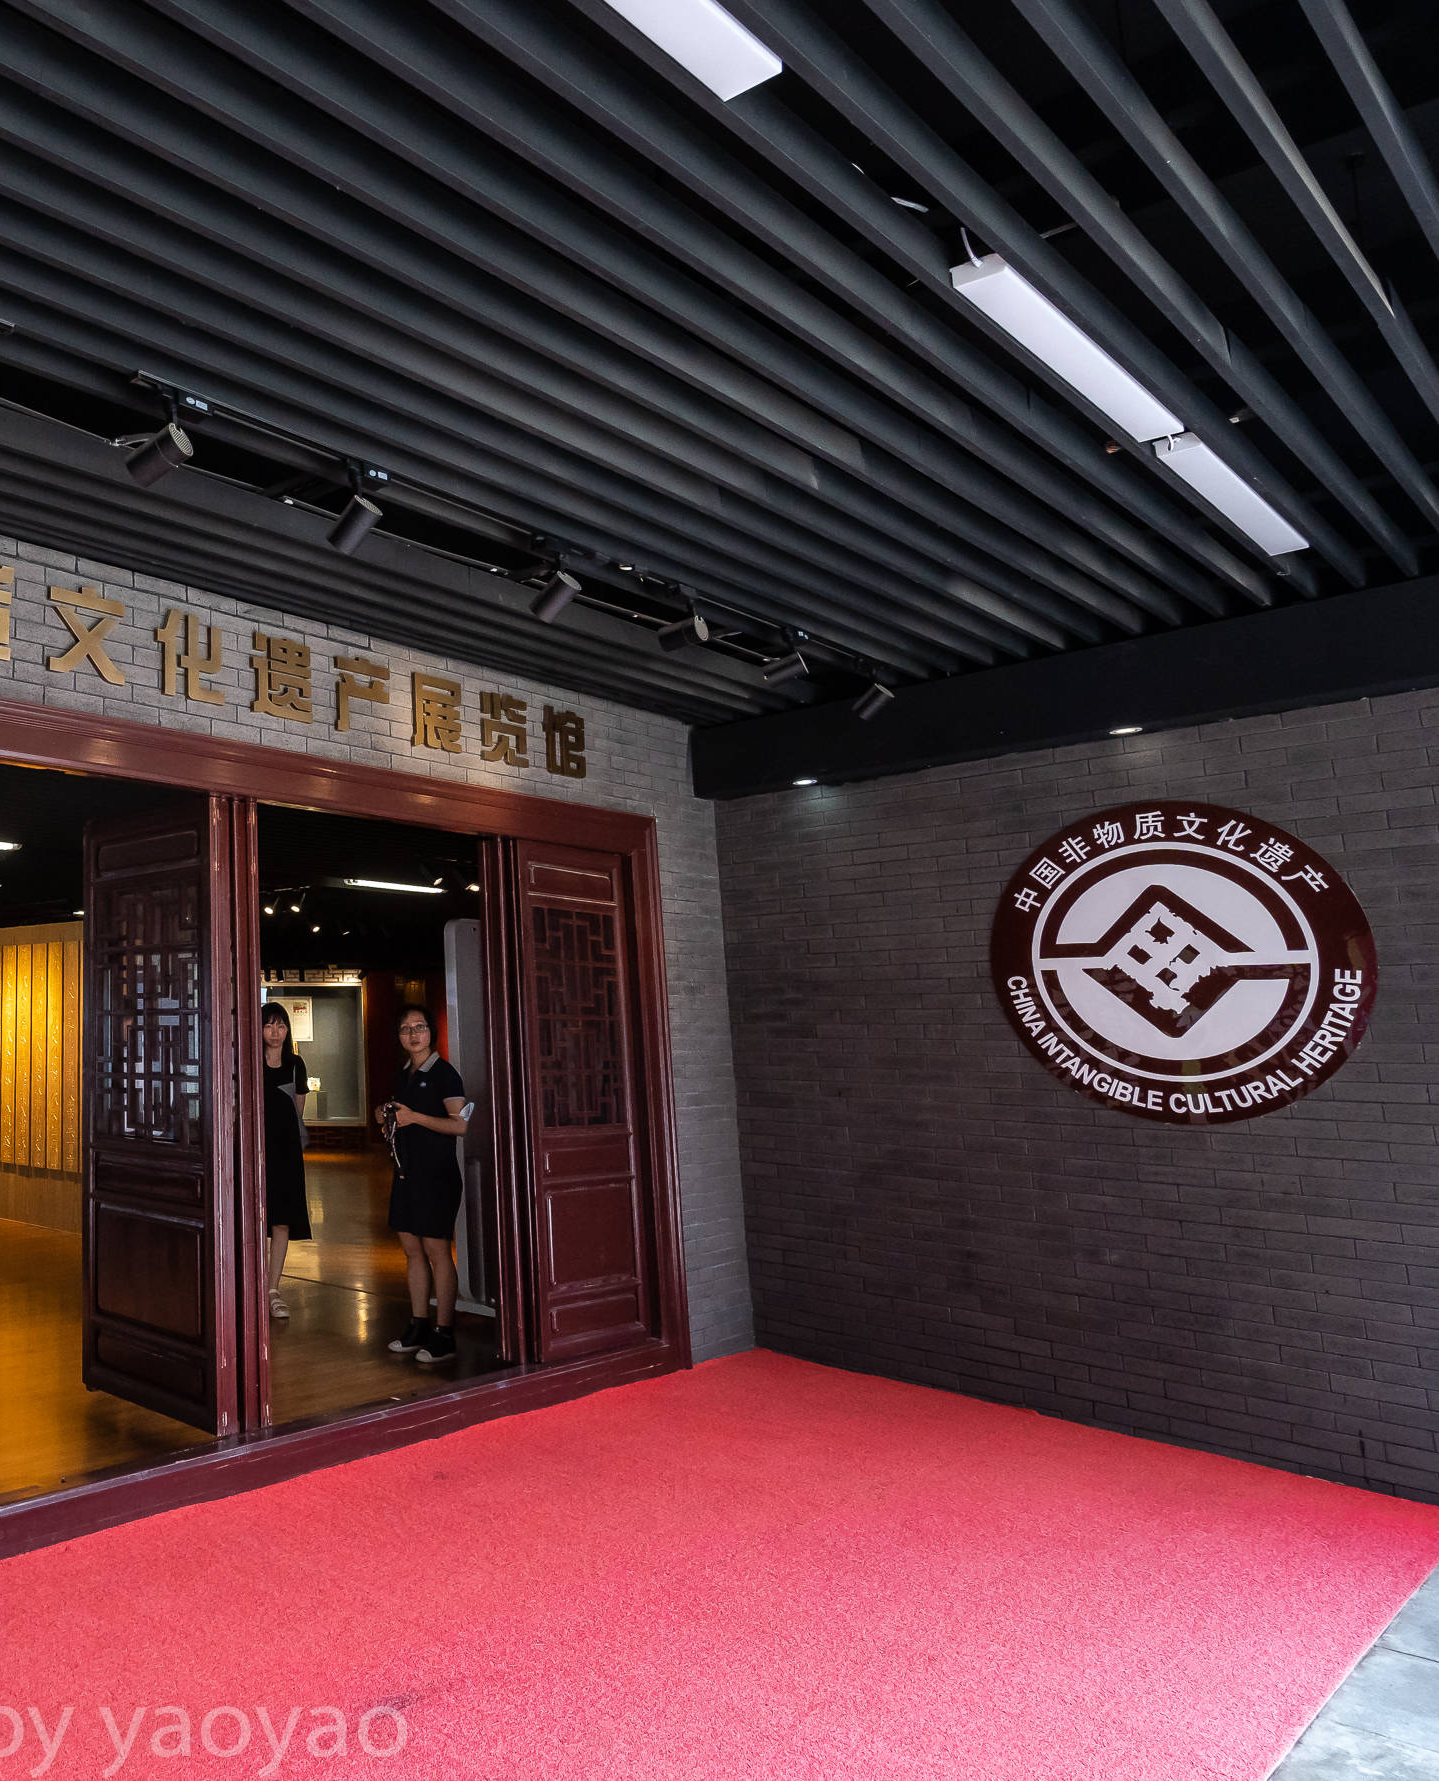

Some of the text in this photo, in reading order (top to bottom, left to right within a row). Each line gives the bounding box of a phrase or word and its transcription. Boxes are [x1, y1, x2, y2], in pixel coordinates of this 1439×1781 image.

[1013, 811, 1330, 914] 中国非物质文化遗产
[1006, 967, 1363, 1114] CHINA INTANGIBLE CULTURAL HERITAGE
